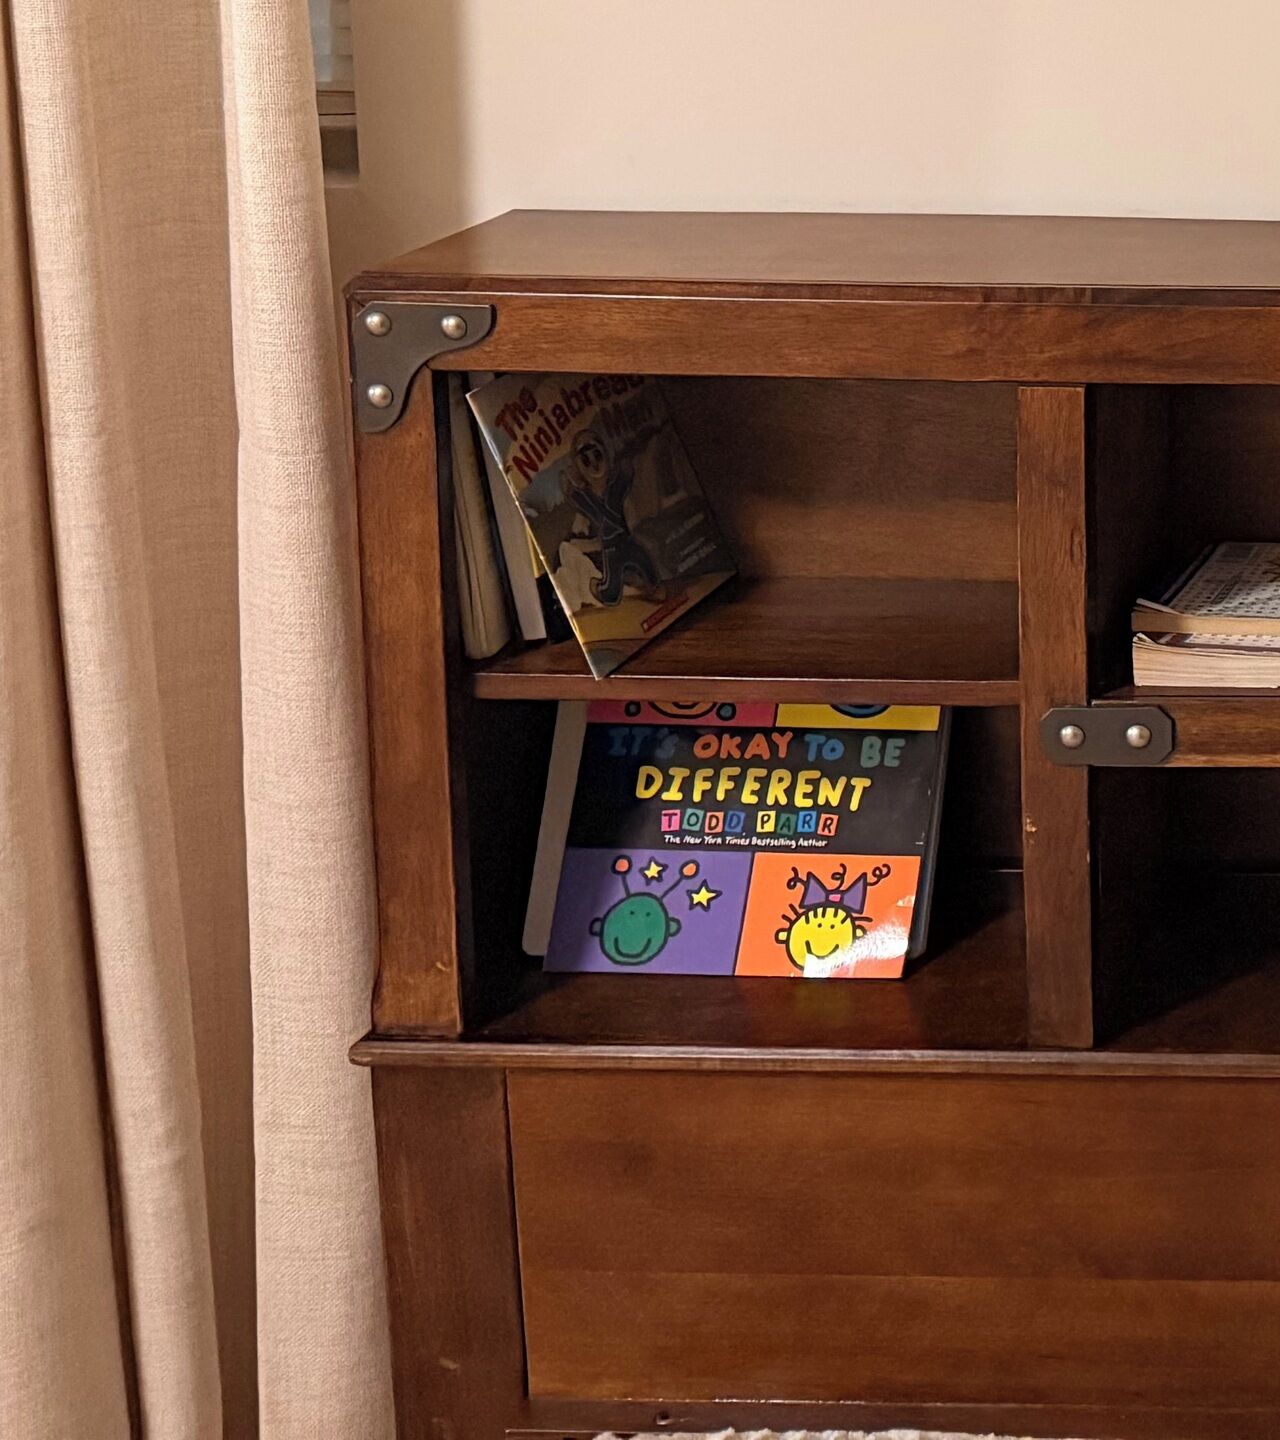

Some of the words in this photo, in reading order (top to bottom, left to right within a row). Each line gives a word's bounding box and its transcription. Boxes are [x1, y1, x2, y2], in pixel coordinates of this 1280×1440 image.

[495, 386, 537, 442] The
[609, 727, 680, 760] IT'S
[693, 731, 794, 760] OKAY
[804, 733, 845, 762] TO
[860, 735, 906, 768] BE
[635, 765, 872, 812] DIFFERENT
[662, 809, 745, 833] TODD
[757, 811, 838, 836] PARR
[664, 834, 681, 845] The
[683, 835, 702, 845] New
[704, 835, 722, 845] York
[725, 834, 750, 846] Times
[751, 837, 797, 849] Bestselling
[797, 838, 828, 848] Author
